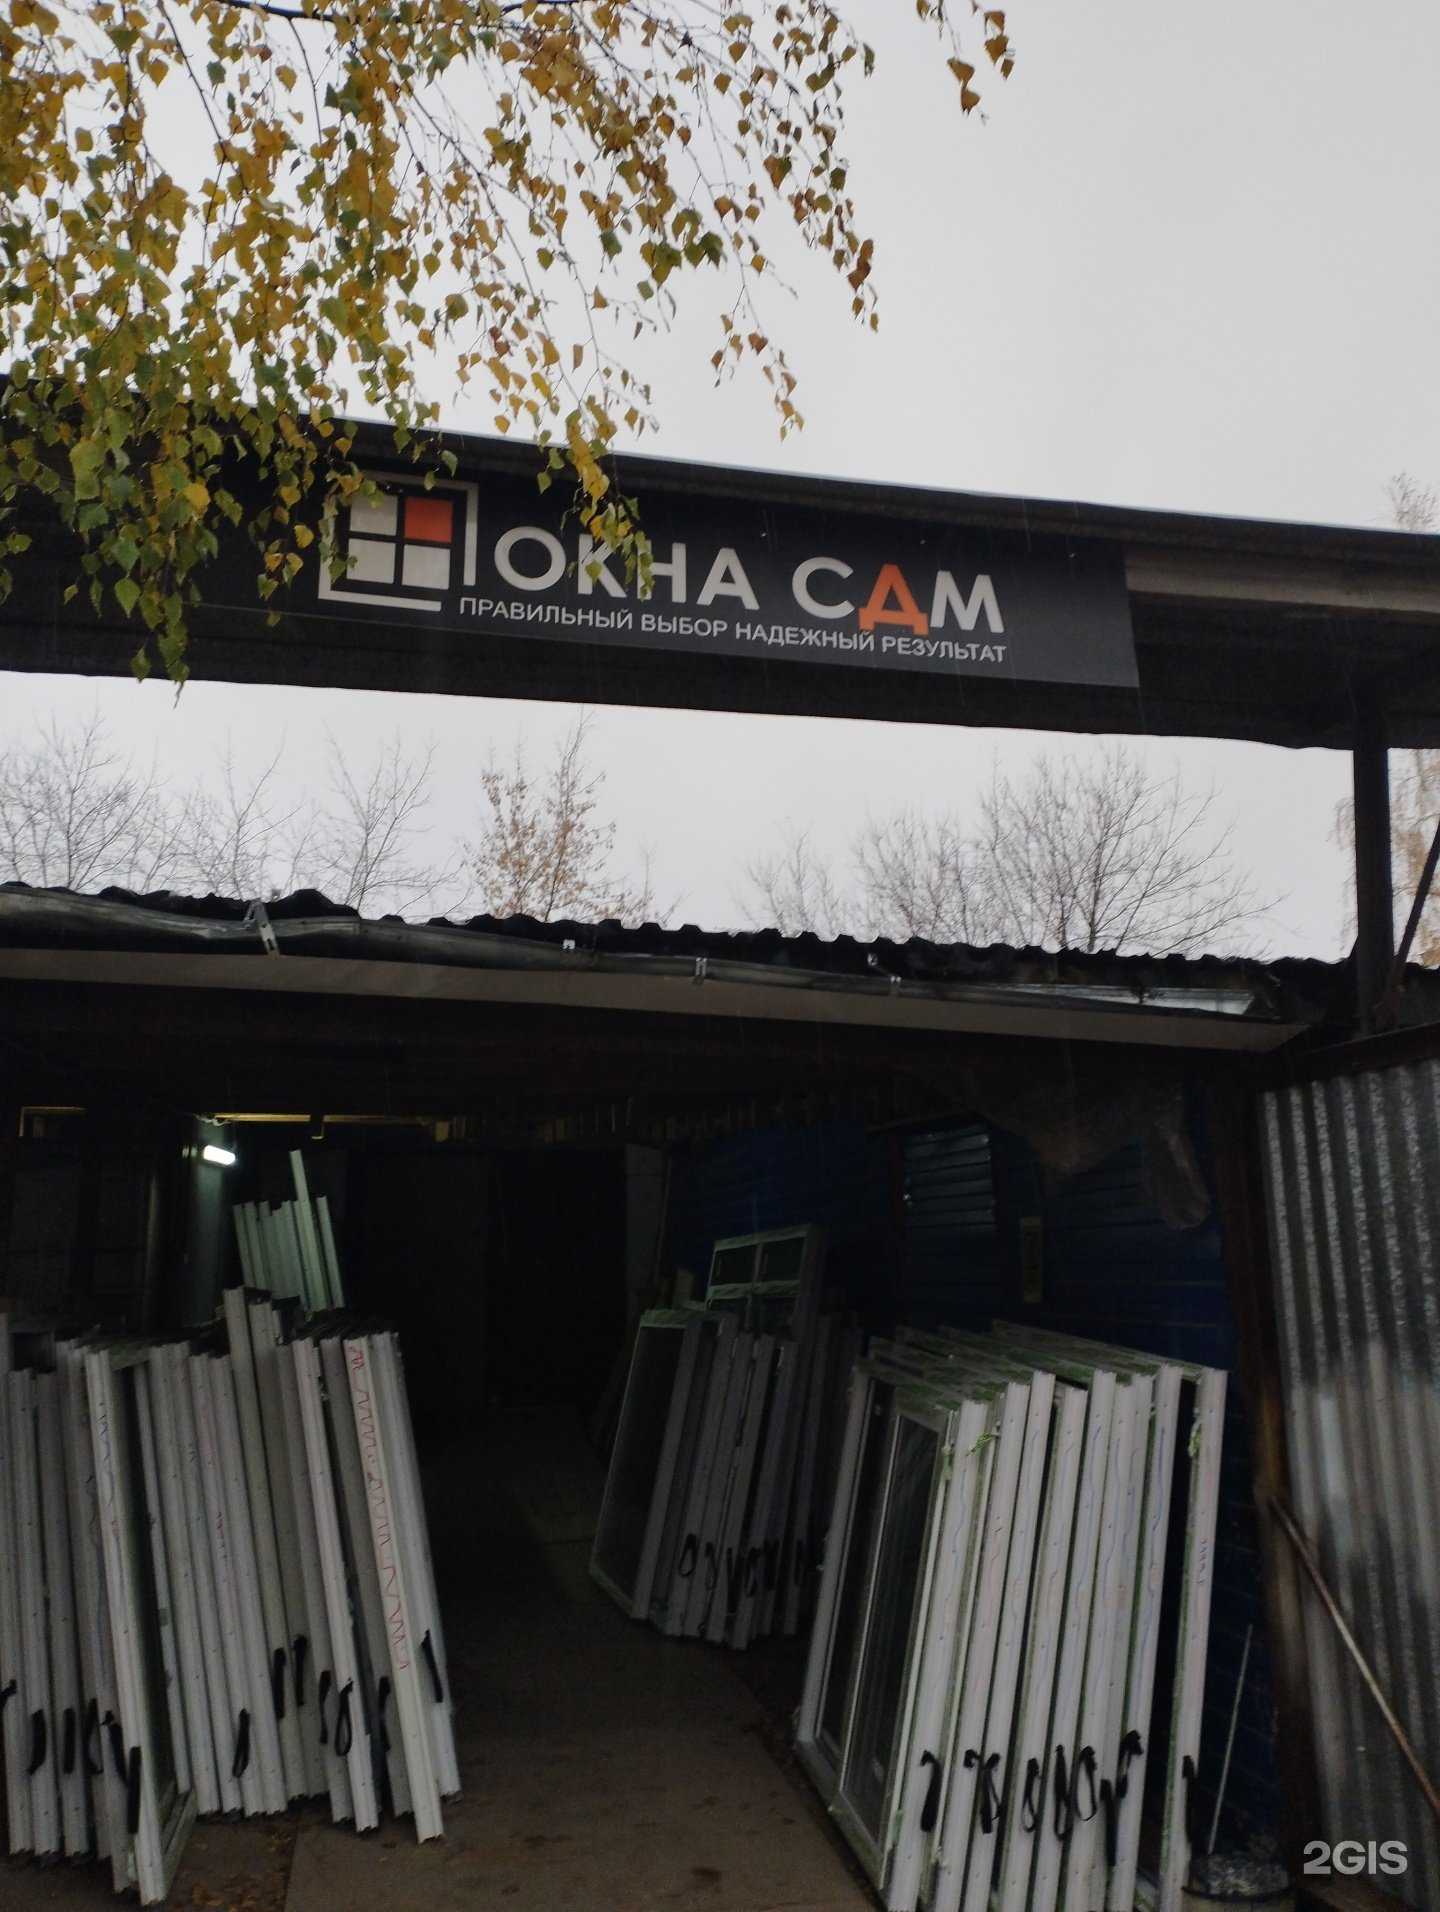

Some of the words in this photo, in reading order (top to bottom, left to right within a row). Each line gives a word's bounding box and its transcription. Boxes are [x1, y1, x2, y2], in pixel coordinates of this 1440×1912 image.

[494, 526, 760, 610] ОКНА
[460, 597, 633, 630] ПРАВИЛЬНЫЙ
[641, 614, 728, 637] ВЫБОР
[736, 622, 874, 651] НАДЕЖНЫЙ
[882, 636, 1007, 663] РЕЗУЛЬТАТ
